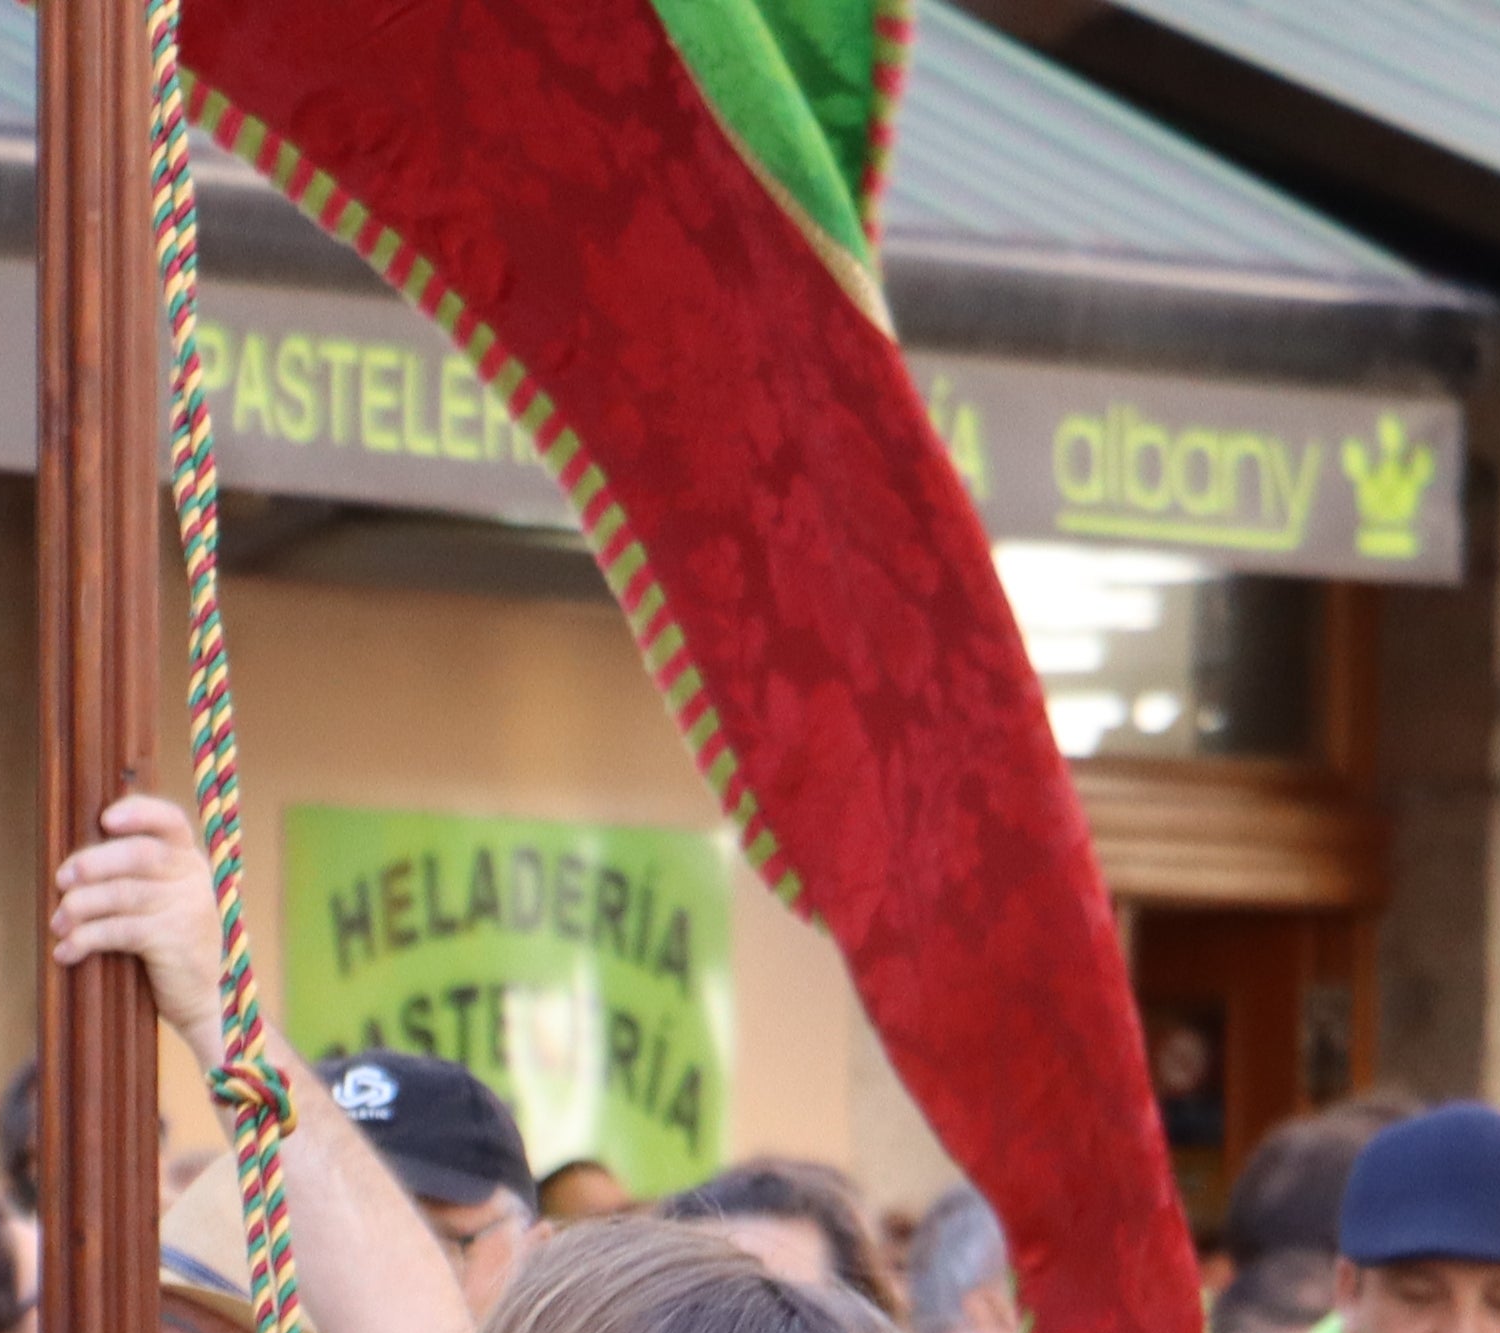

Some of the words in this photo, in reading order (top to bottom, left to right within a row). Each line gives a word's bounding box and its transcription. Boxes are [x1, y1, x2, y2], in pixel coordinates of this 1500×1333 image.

[192, 324, 548, 466] PASTELER
[1052, 400, 1325, 550] albany
[327, 845, 694, 995] HELADERÍA
